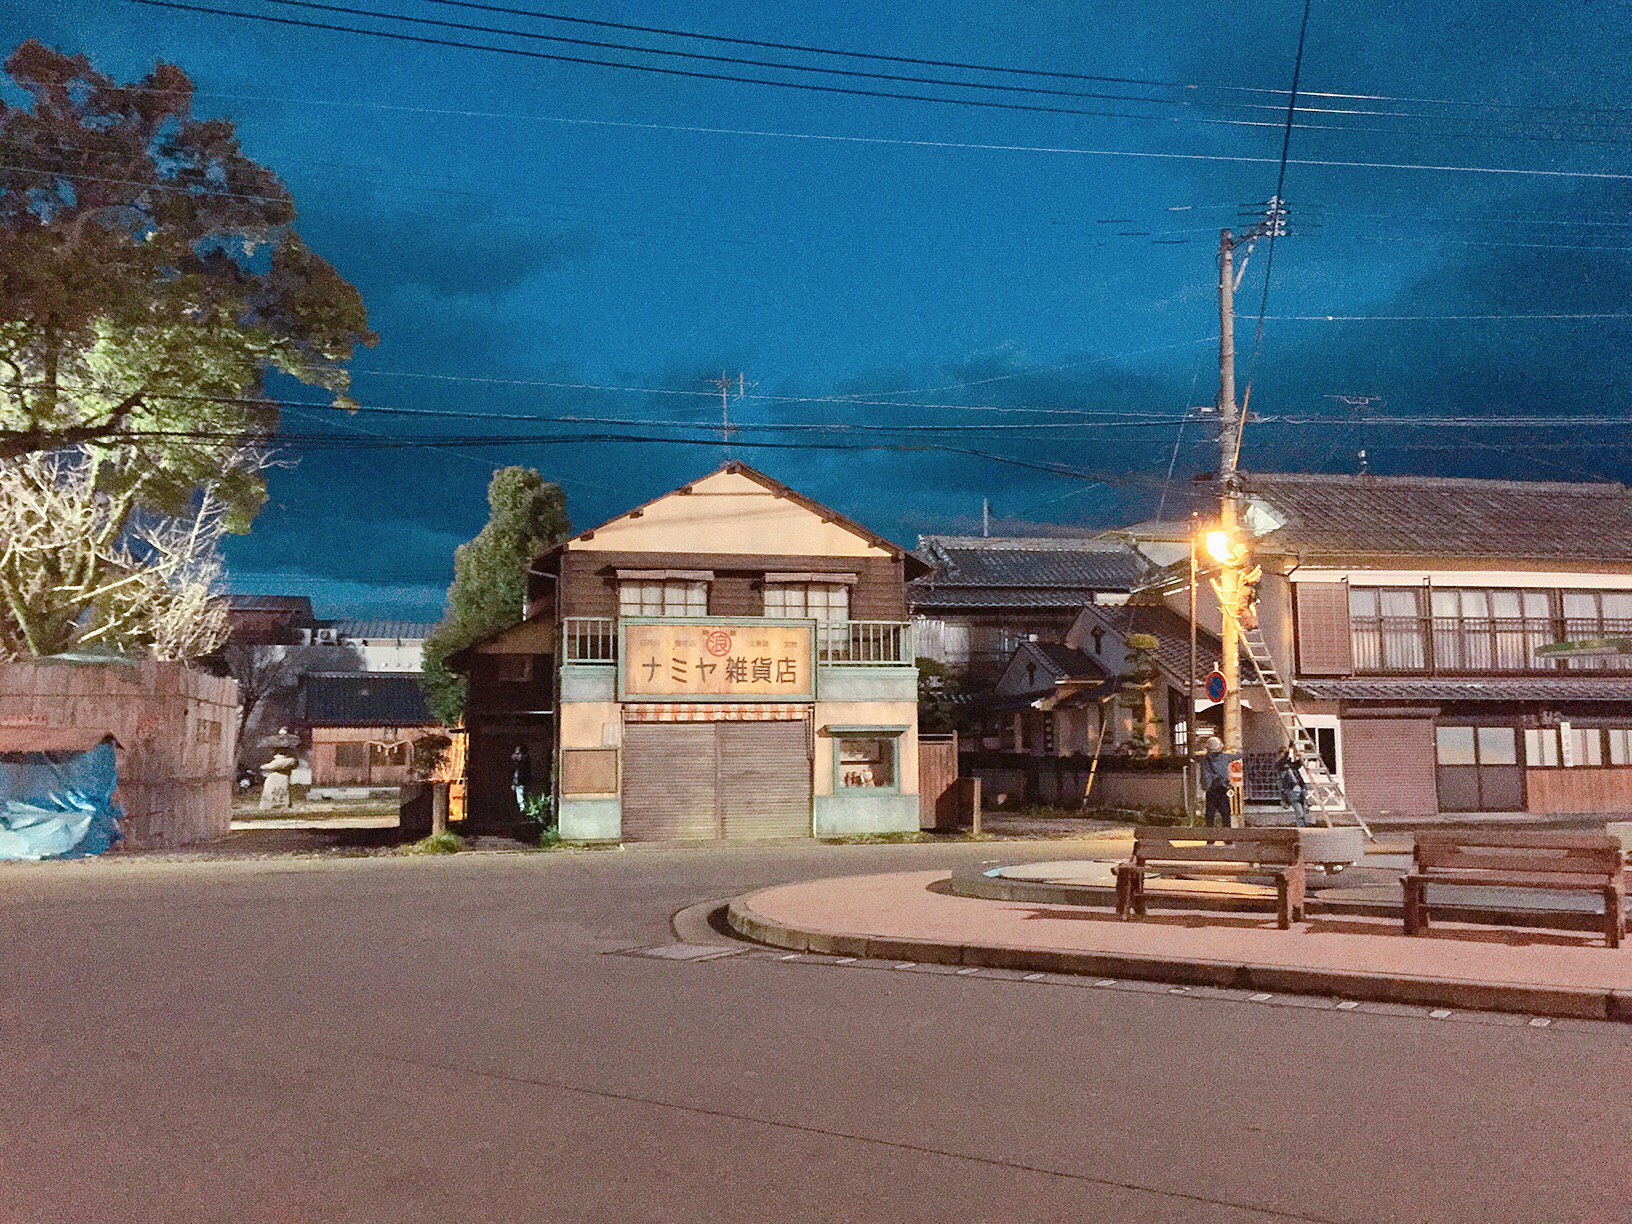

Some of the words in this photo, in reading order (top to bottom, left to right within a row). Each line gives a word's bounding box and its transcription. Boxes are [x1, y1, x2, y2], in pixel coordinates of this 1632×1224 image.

[708, 633, 730, 655] 浪
[642, 656, 797, 684] ナミヤ雑貨店
